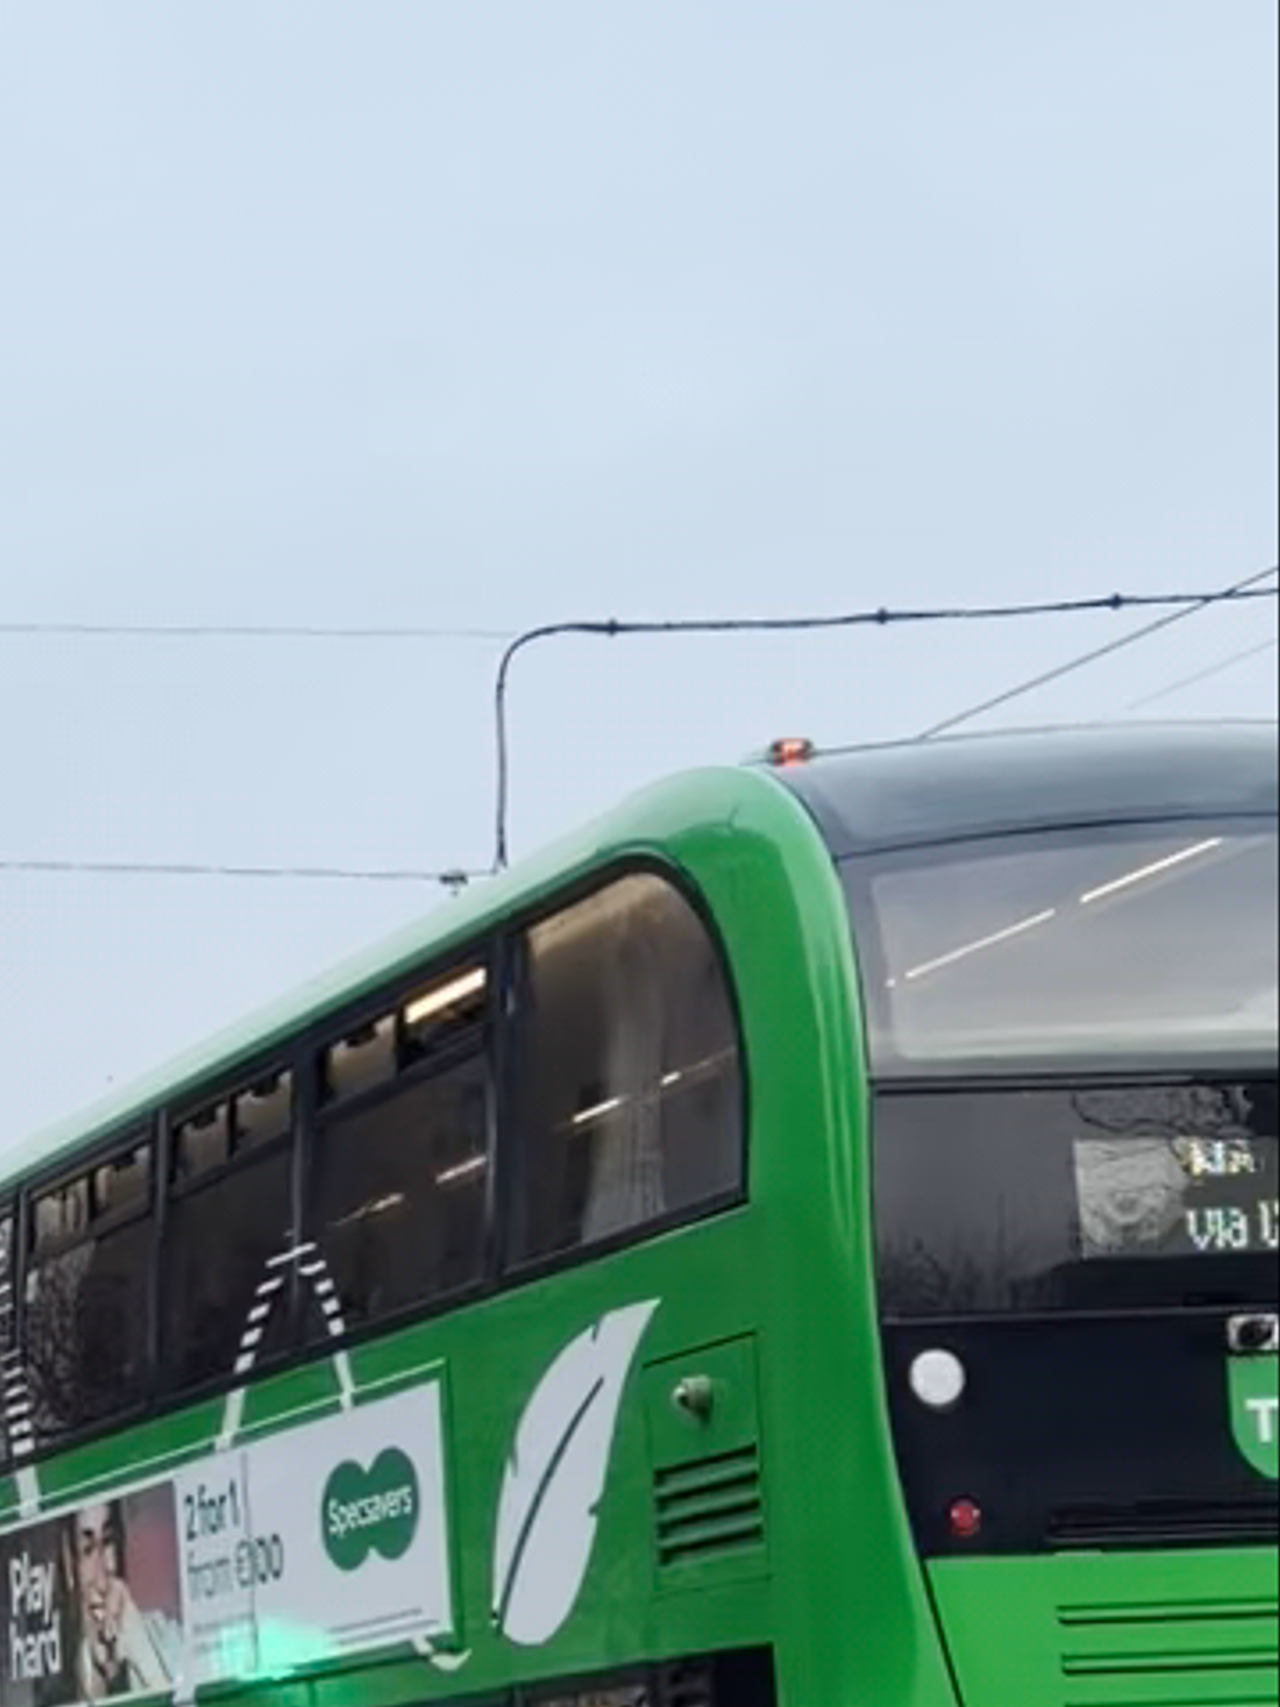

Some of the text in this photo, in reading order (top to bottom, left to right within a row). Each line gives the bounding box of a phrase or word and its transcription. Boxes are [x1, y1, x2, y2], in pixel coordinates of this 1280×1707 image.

[185, 1494, 197, 1541] 2
[198, 1484, 228, 1535] for
[328, 1484, 413, 1537] Specsavers
[9, 1551, 57, 1624] Play
[10, 1609, 62, 1680] hard
